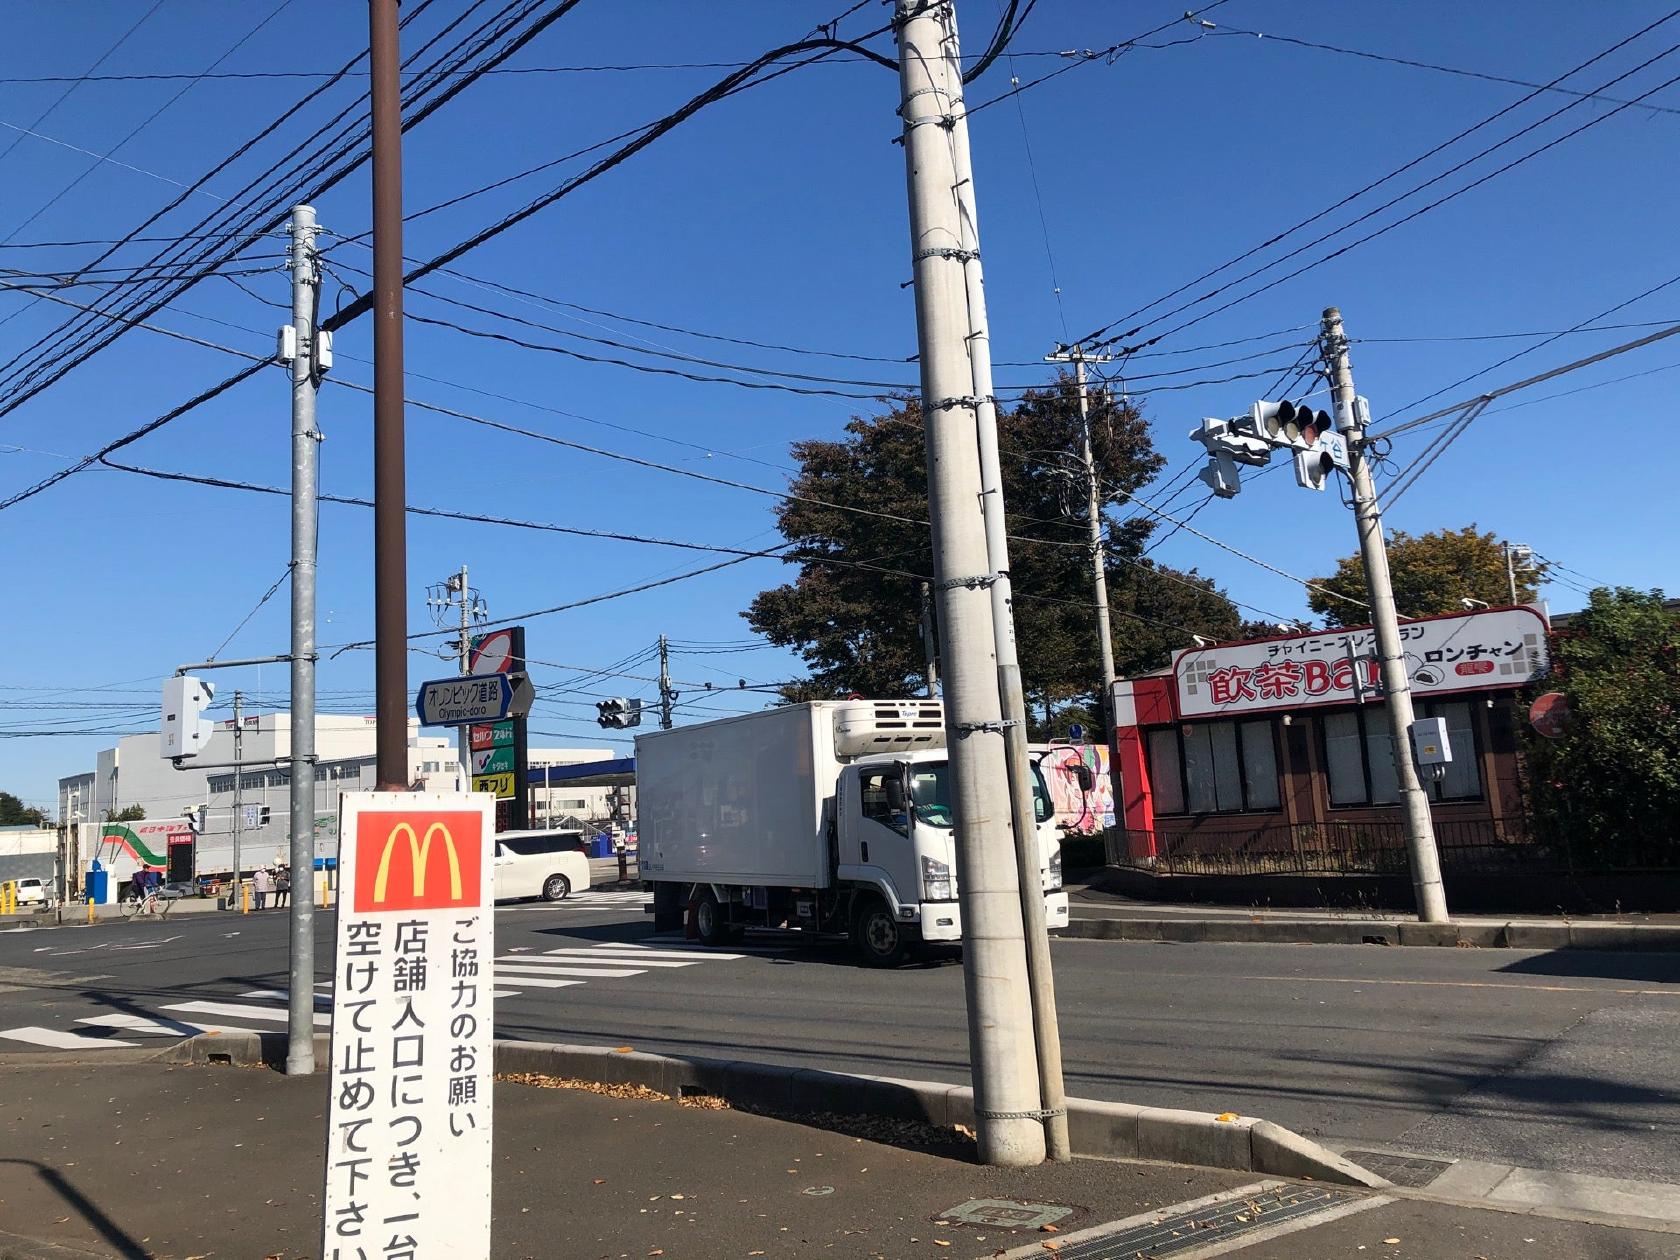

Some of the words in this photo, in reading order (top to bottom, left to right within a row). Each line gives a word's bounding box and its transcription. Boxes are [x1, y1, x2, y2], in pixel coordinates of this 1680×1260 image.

[1425, 640, 1524, 663] ロンチャン
[429, 682, 498, 706] オリンピック道路
[439, 706, 487, 720] Olympic-doro
[448, 916, 480, 1138] ご協力のお願い
